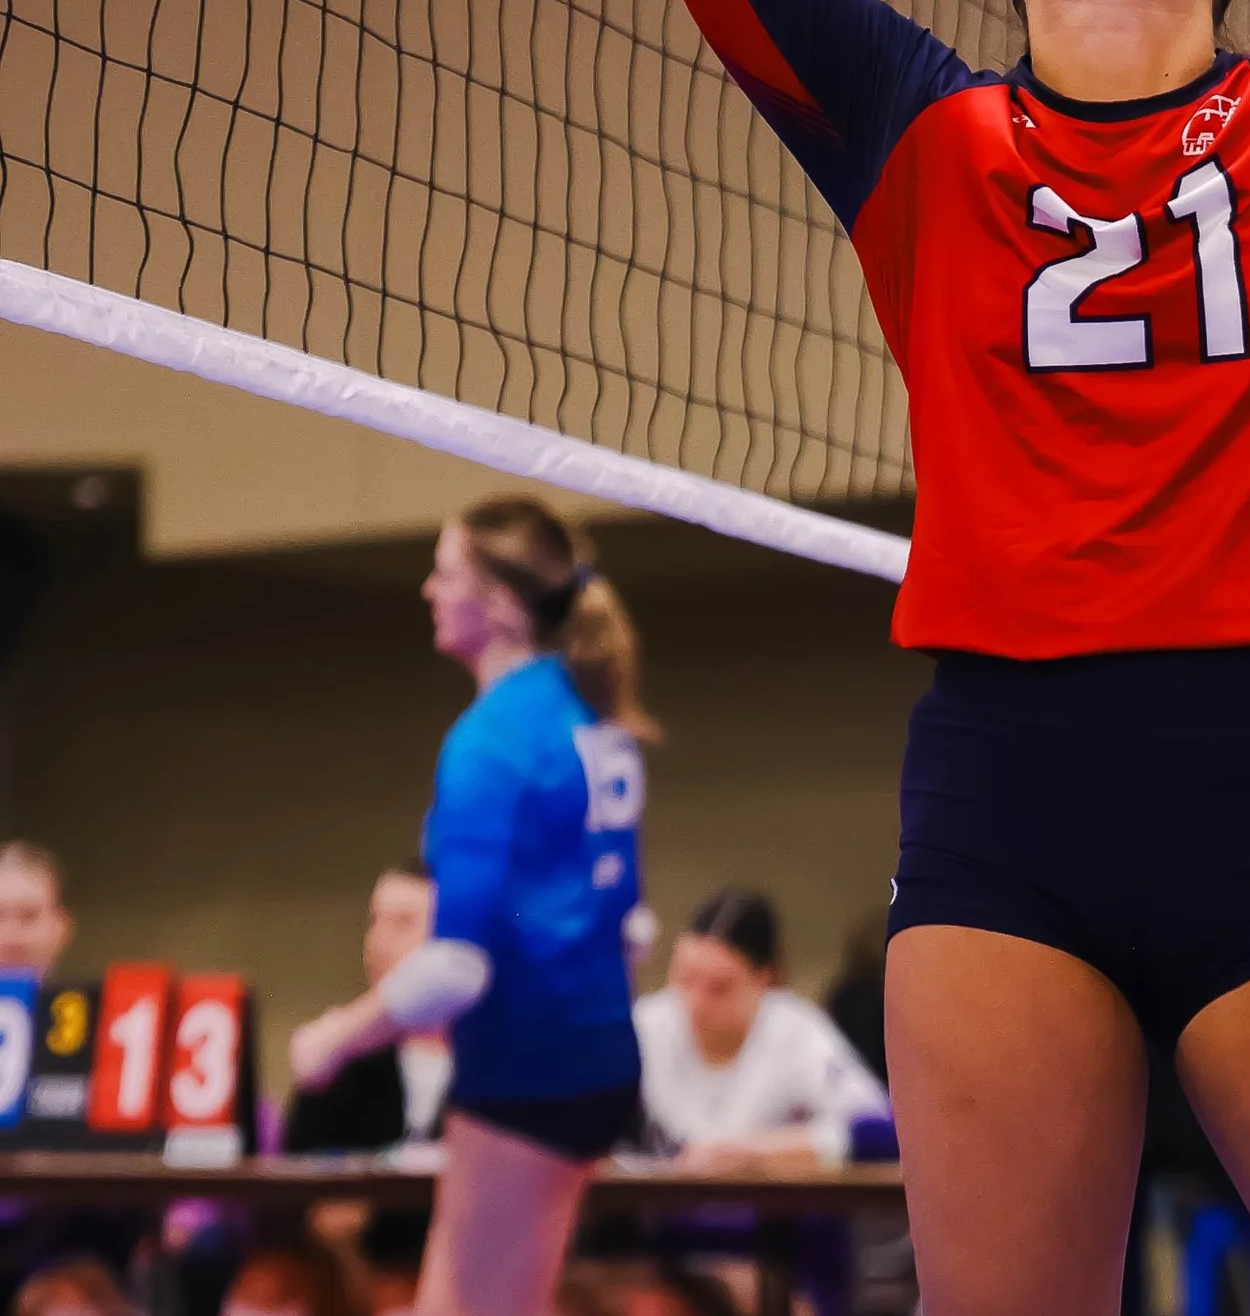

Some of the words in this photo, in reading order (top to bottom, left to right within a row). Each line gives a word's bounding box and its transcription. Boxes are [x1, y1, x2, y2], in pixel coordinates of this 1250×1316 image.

[1022, 154, 1250, 372] 21
[46, 990, 88, 1057] 3
[109, 996, 237, 1120] 13
